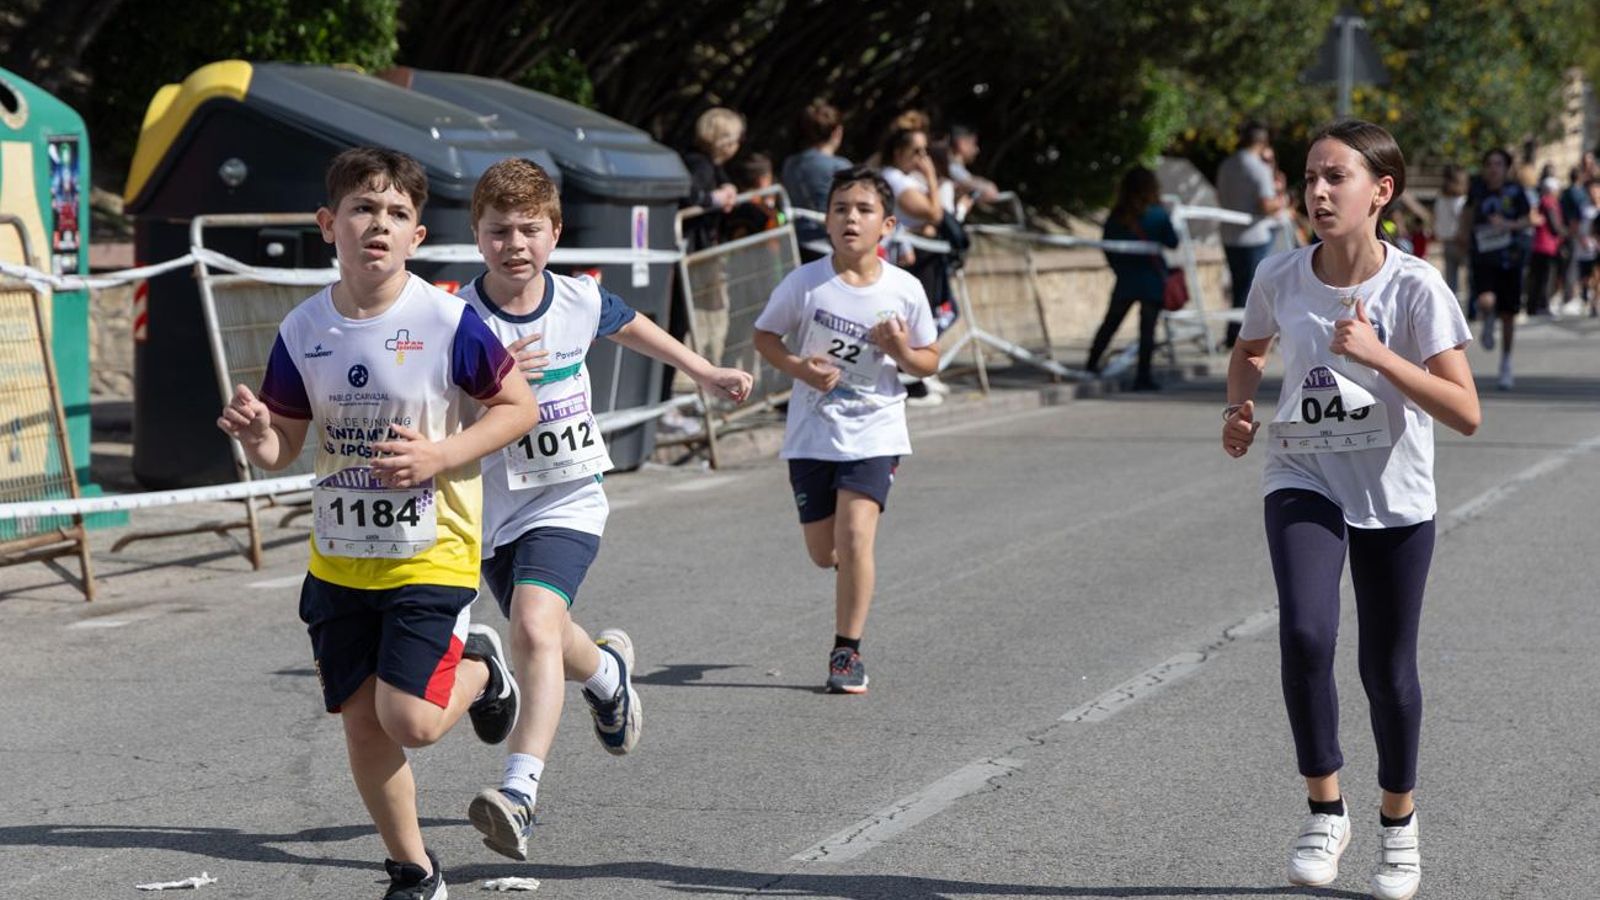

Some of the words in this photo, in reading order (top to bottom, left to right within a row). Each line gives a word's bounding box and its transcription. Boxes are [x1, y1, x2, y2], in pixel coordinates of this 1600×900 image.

[556, 348, 582, 360] Poveda
[827, 339, 861, 364] 22
[518, 422, 594, 460] 1012
[330, 496, 421, 528] 1184
